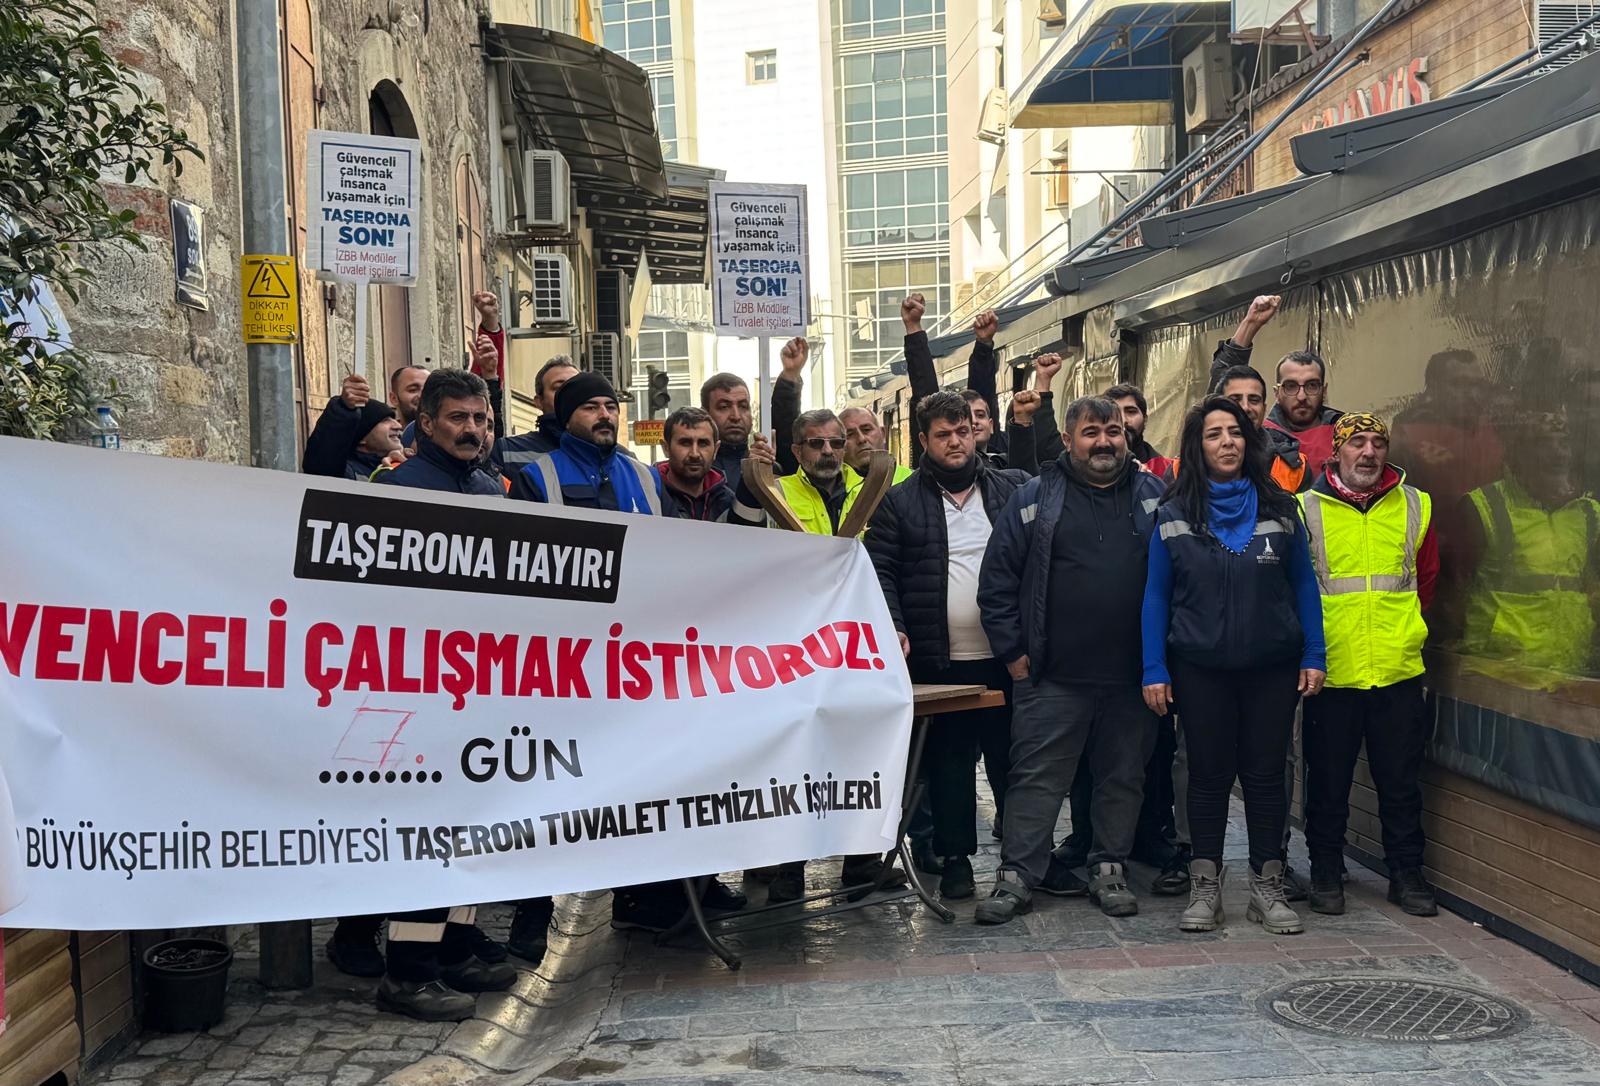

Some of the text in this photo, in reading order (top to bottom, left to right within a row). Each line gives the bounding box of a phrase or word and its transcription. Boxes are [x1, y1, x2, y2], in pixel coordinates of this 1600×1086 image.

[336, 152, 396, 167] Güvenceli
[340, 166, 393, 180] çalışmak
[340, 177, 386, 191] insanca
[327, 191, 405, 207] yaşamak için
[730, 201, 786, 213] Güvenceli
[322, 207, 410, 227] TAŞERONA
[734, 215, 785, 227] çalışmak
[338, 226, 394, 247] SON!
[735, 227, 779, 238] insanca
[723, 241, 795, 254] yaşamak için
[336, 248, 396, 263] İZBB Modüler
[334, 263, 398, 278] Tuvalet işçileri
[719, 259, 802, 276] TAŞERONA
[735, 276, 787, 296] SON!
[249, 301, 289, 310] DİKKAT!
[757, 302, 790, 314] Modüler
[254, 311, 284, 321] ÖLÜM
[732, 316, 792, 329] Tuvalet işçileri
[246, 323, 295, 333] TEHLİKESİ
[306, 519, 615, 589] TAŞERONA HAYIR!
[304, 622, 593, 711] ÇALIŞMAK
[606, 621, 886, 701] İSTİYORUZ!
[460, 725, 584, 783] GÜN
[26, 771, 882, 881] BÜYÜKŞEHİR BELEDİYESİ TAŞERON TUVALET TEMİZLİK İŞÇİLERİ
